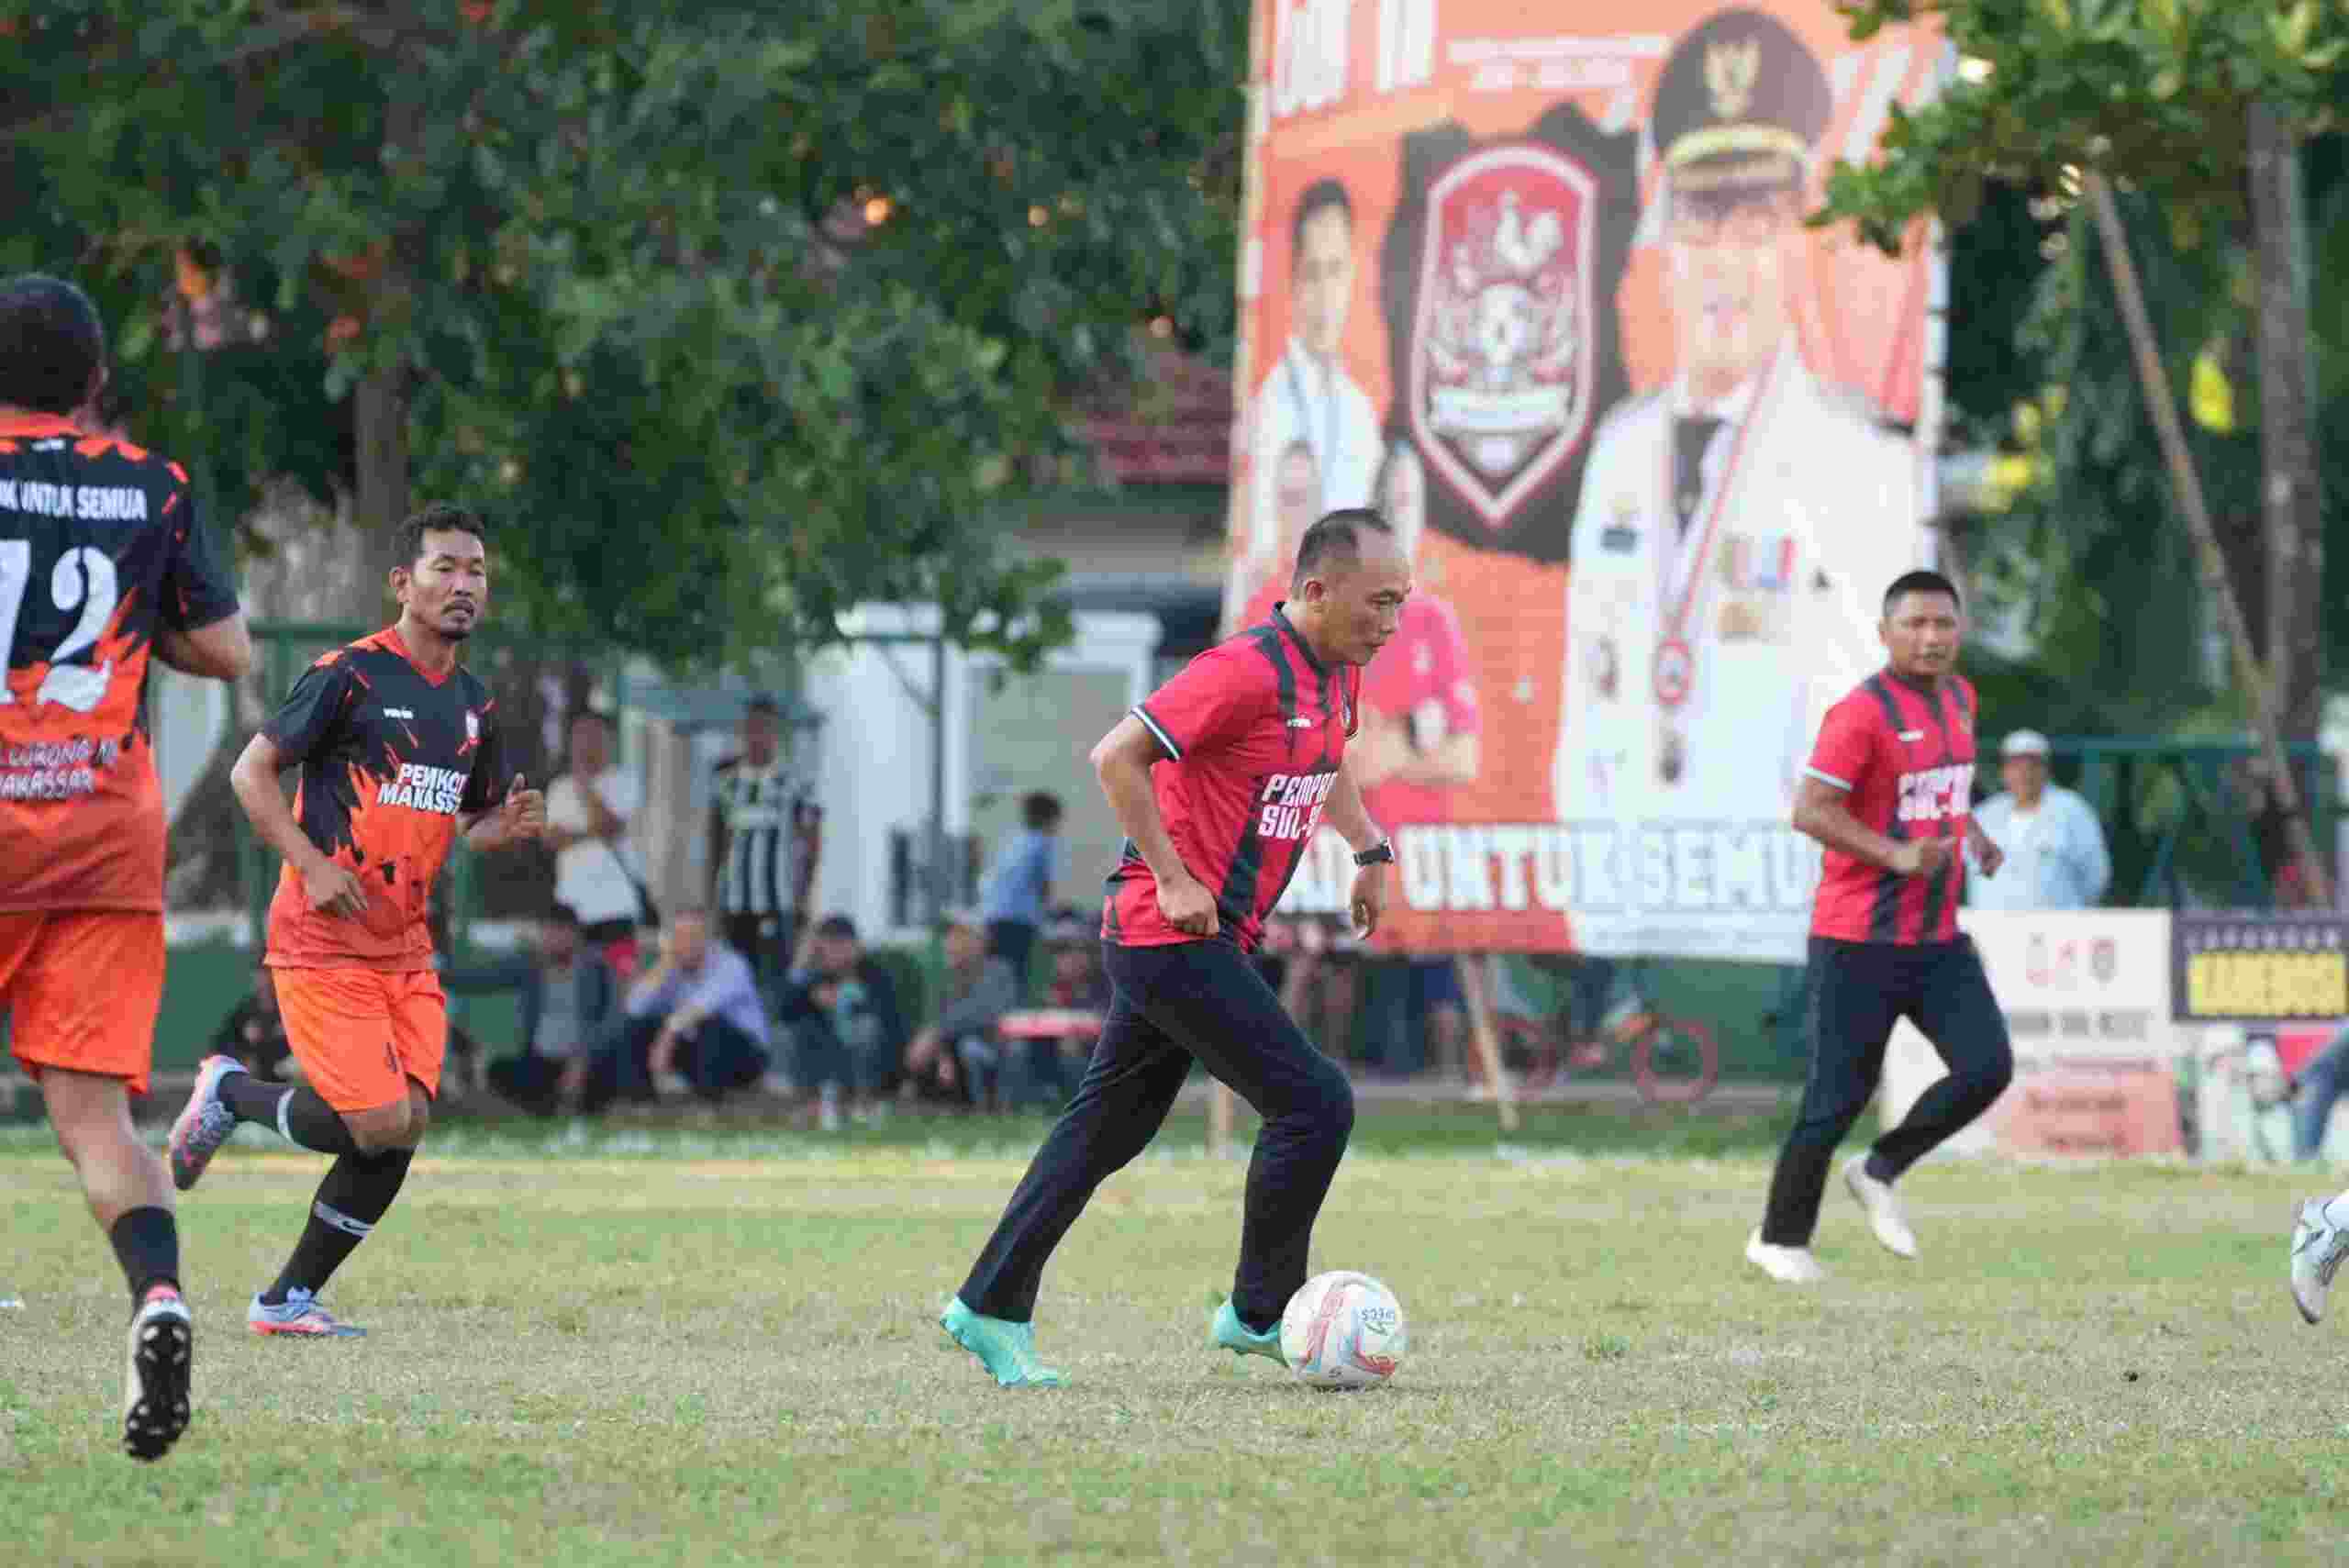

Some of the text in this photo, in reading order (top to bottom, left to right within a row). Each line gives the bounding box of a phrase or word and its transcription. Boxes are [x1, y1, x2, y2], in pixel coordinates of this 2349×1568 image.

[76, 486, 147, 520] SEMUA
[1399, 828, 1626, 911] UNTUK
[1637, 828, 1820, 912] SEMU
